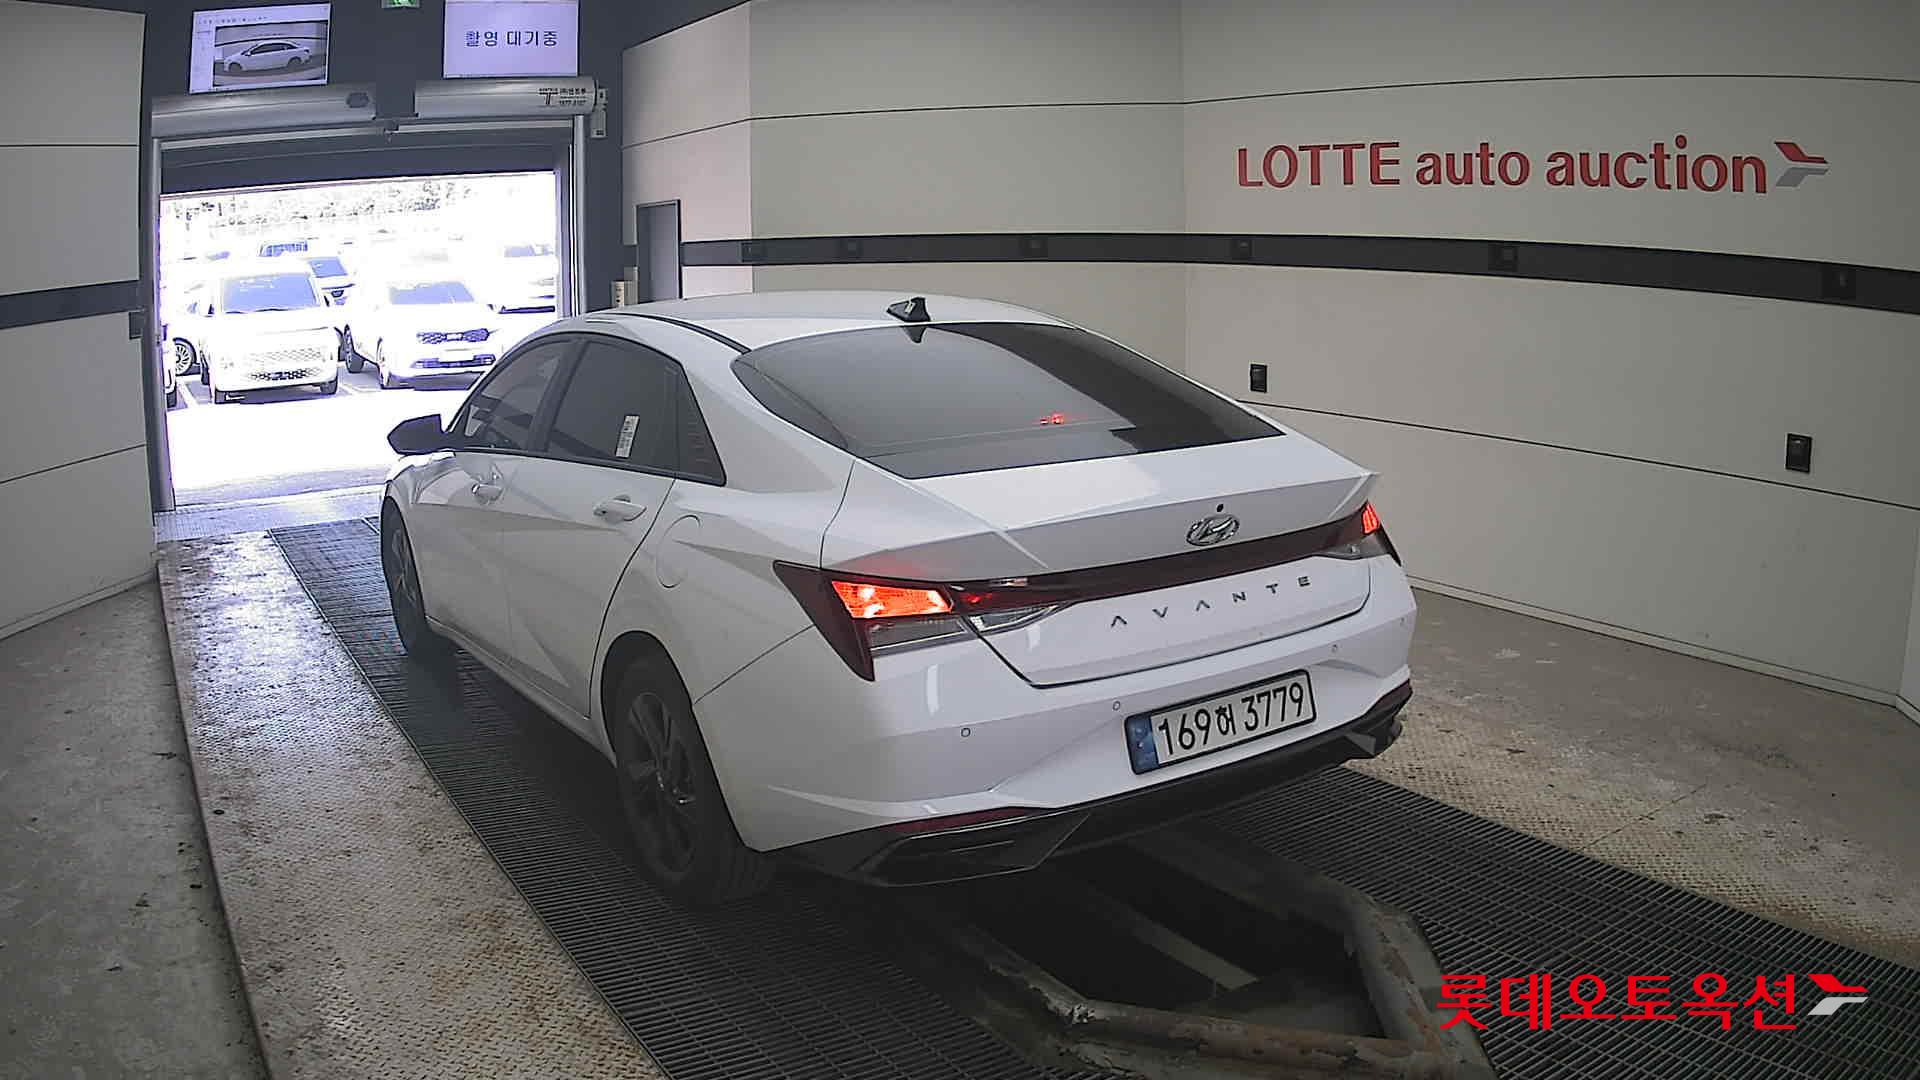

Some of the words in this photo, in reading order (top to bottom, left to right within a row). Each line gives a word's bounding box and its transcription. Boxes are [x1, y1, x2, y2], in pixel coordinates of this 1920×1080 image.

[1236, 142, 1400, 188] LOTTE
[1416, 142, 1531, 187] auto
[1546, 135, 1767, 194] auction
[1110, 575, 1311, 628] AVANTE
[1158, 703, 1238, 756] 169허
[1240, 682, 1304, 732] 3779
